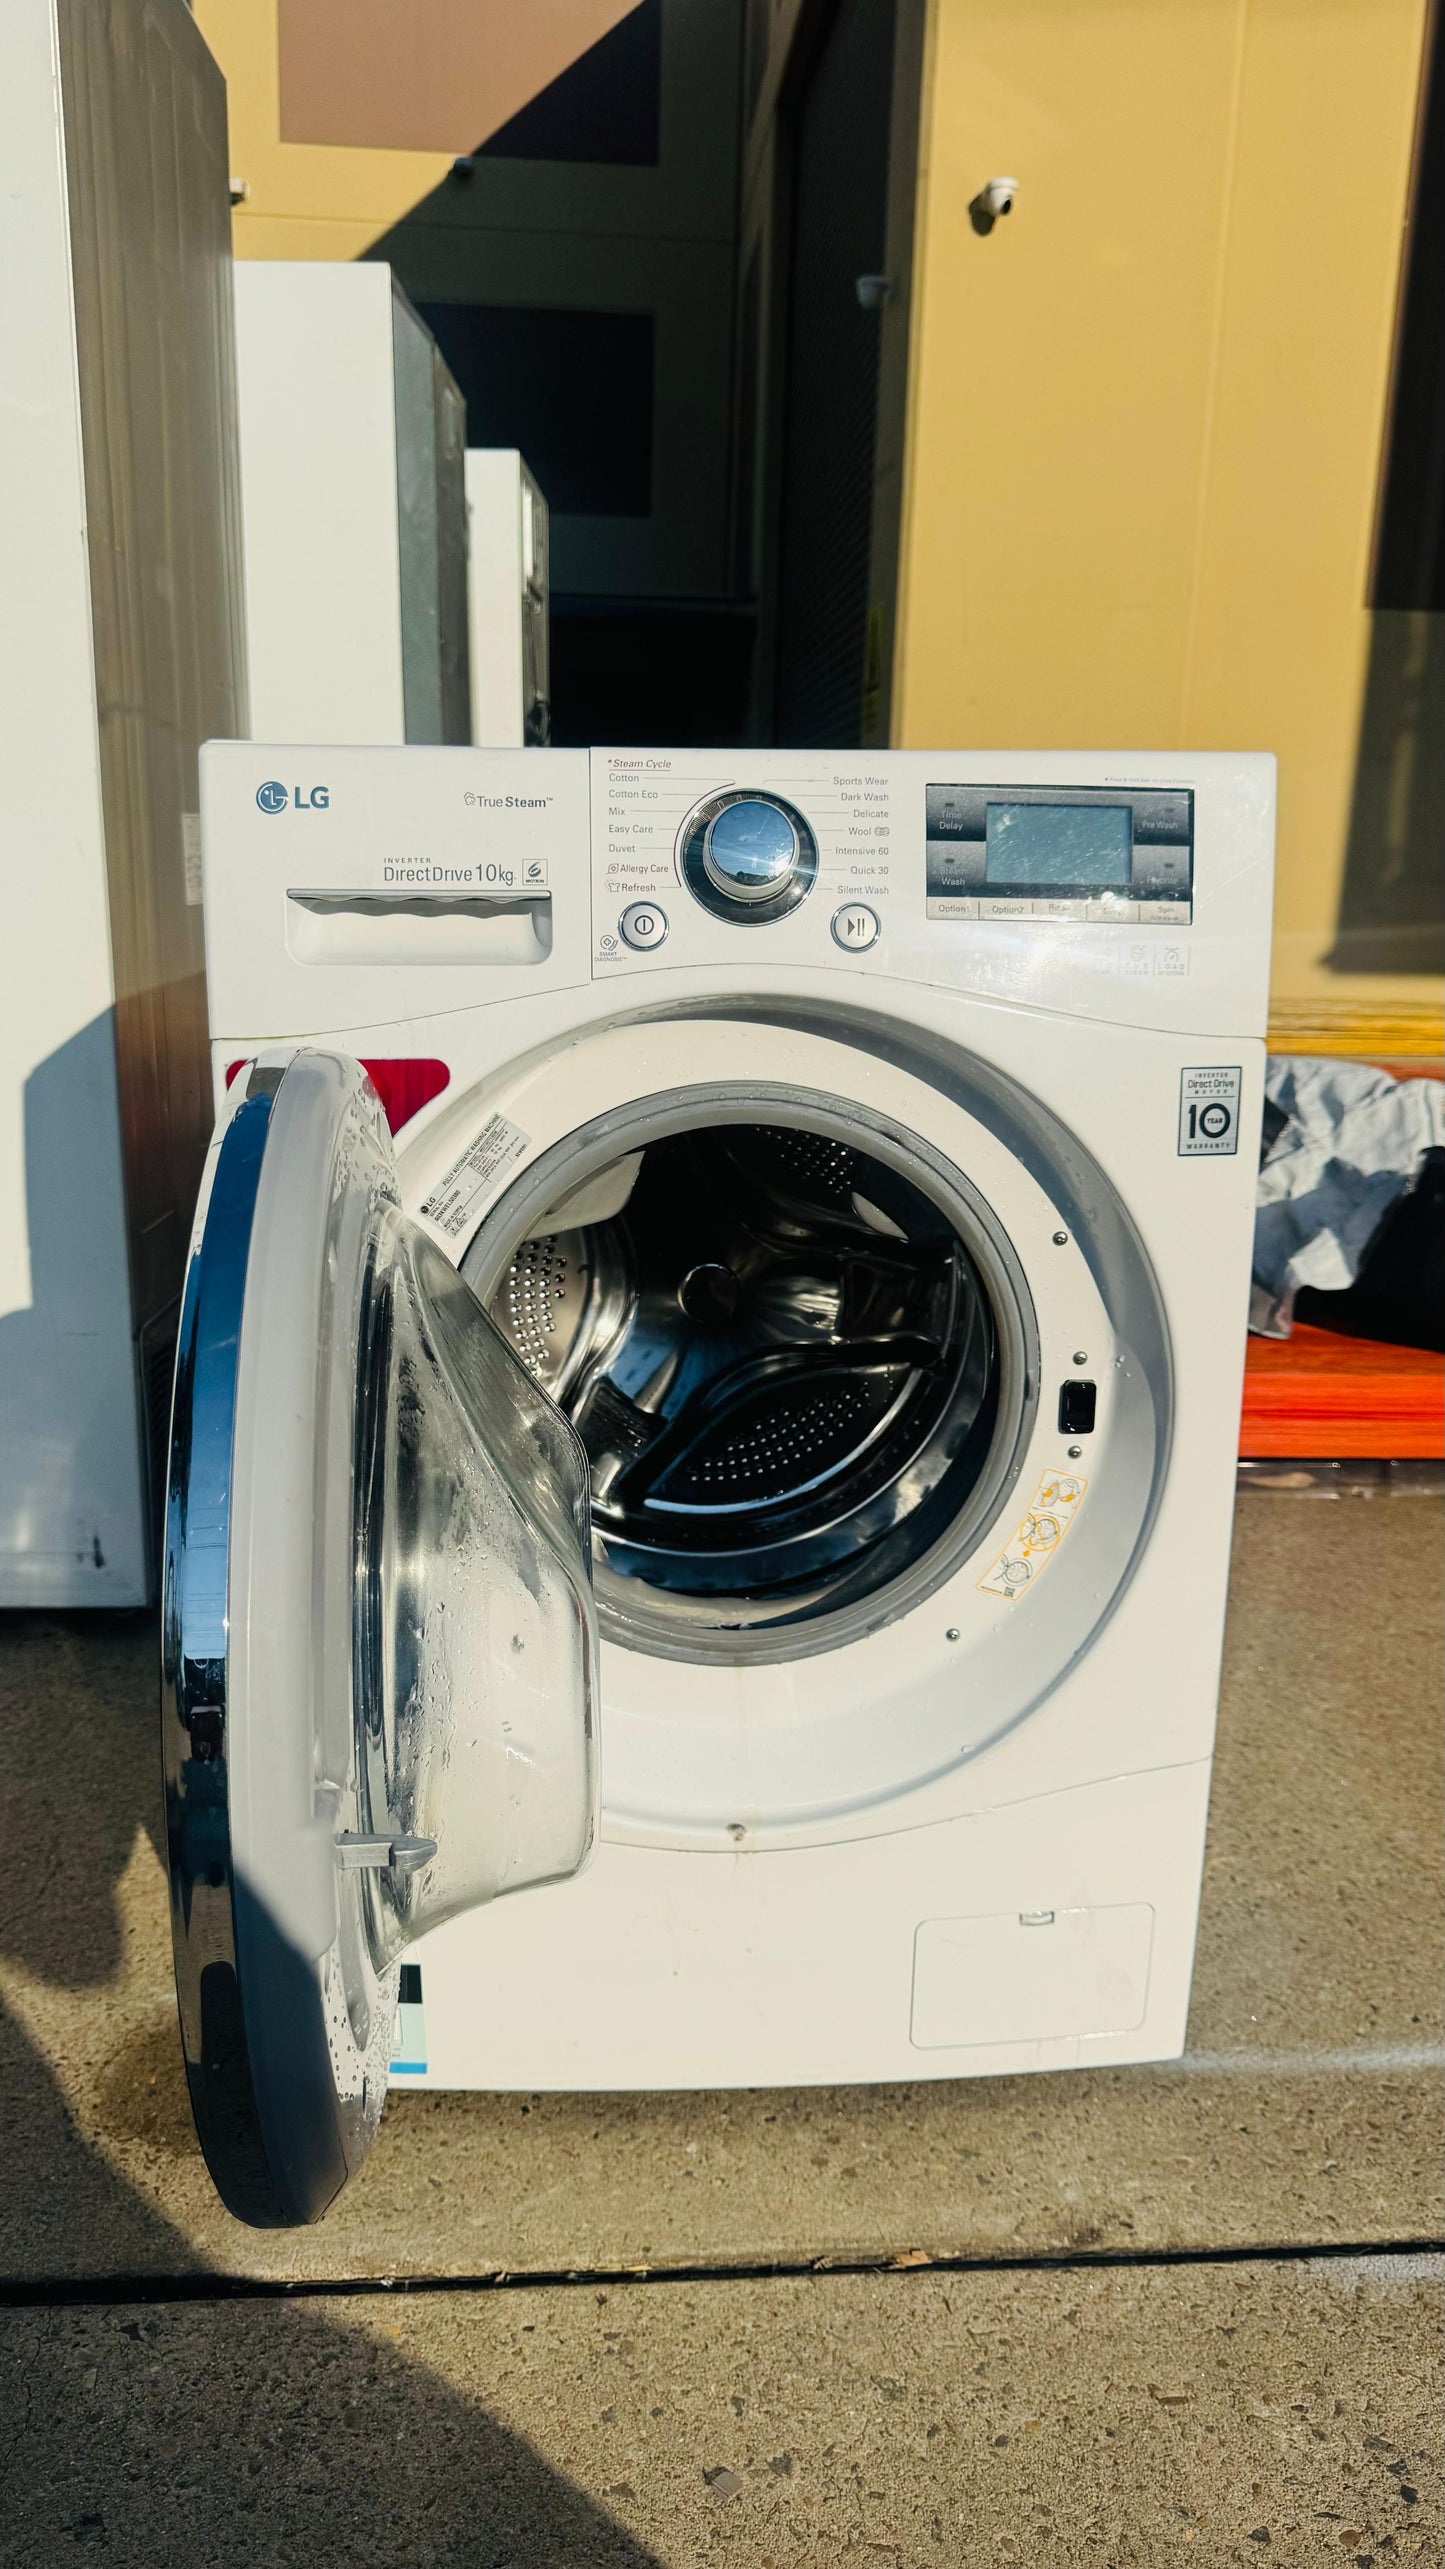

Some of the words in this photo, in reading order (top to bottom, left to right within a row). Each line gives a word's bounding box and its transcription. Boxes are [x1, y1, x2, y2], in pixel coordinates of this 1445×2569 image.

[646, 760, 672, 769] Cycle
[608, 774, 639, 782] Cotton
[833, 776, 862, 786] Sports
[865, 777, 888, 786] Wear
[294, 786, 330, 809] LG
[608, 790, 638, 798] Cotton
[642, 790, 658, 798] Eco
[841, 792, 862, 801] Dark
[864, 792, 889, 801] Wash
[477, 796, 503, 808] True
[608, 807, 626, 816] Mix
[853, 809, 889, 818] Delicate
[608, 824, 630, 835] Easy
[632, 824, 654, 834] Care
[939, 821, 964, 832] Delay
[848, 827, 872, 836] Wool
[608, 844, 636, 853] Duvet
[836, 846, 876, 856] Intensive
[878, 846, 889, 856] 60
[620, 864, 648, 874] Allergy
[650, 864, 669, 873] Care
[850, 866, 876, 875] Quick
[878, 866, 889, 875] 30
[384, 866, 430, 882] Direct
[433, 866, 473, 882] Drive
[941, 877, 966, 886] Wash
[621, 883, 656, 892] Refresh
[837, 885, 863, 894] Silent
[865, 886, 889, 894] Wash
[992, 905, 1024, 914] Option2
[1188, 1080, 1213, 1088] Direct
[1214, 1079, 1234, 1088] Drive
[1188, 1102, 1231, 1139] 10
[442, 1173, 454, 1186] FULLY
[453, 1149, 472, 1174] AUTOMATIC
[470, 1131, 487, 1151] WASHING
[484, 1114, 501, 1133] MACHINE
